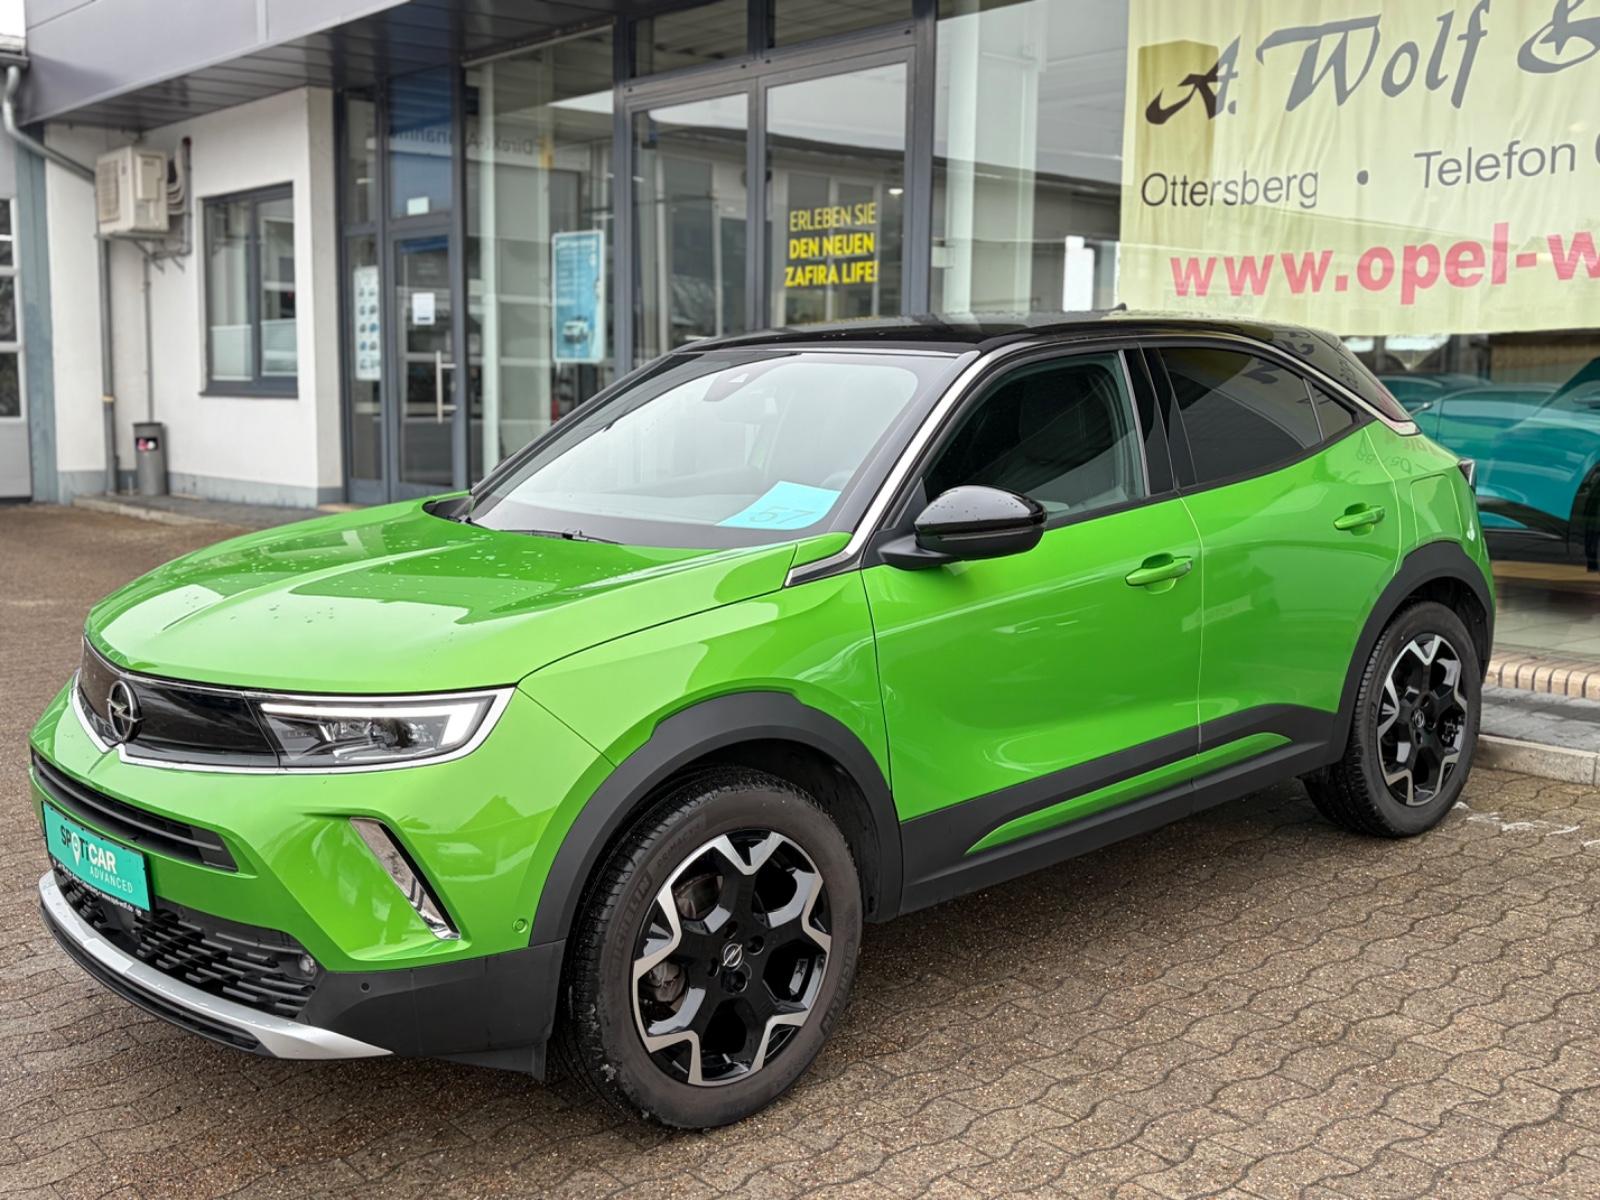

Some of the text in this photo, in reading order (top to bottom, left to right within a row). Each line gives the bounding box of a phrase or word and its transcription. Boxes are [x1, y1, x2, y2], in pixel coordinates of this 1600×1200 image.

[1255, 0, 1490, 112] Wolf
[1141, 170, 1319, 208] Ottersberg
[1414, 139, 1576, 189] Telefon
[789, 203, 877, 232] ERLEBEN SIE
[789, 232, 875, 260] DEN NEUEN
[784, 260, 879, 287] ZAFIRA LIFE!
[89, 866, 133, 894] ADVANCED
